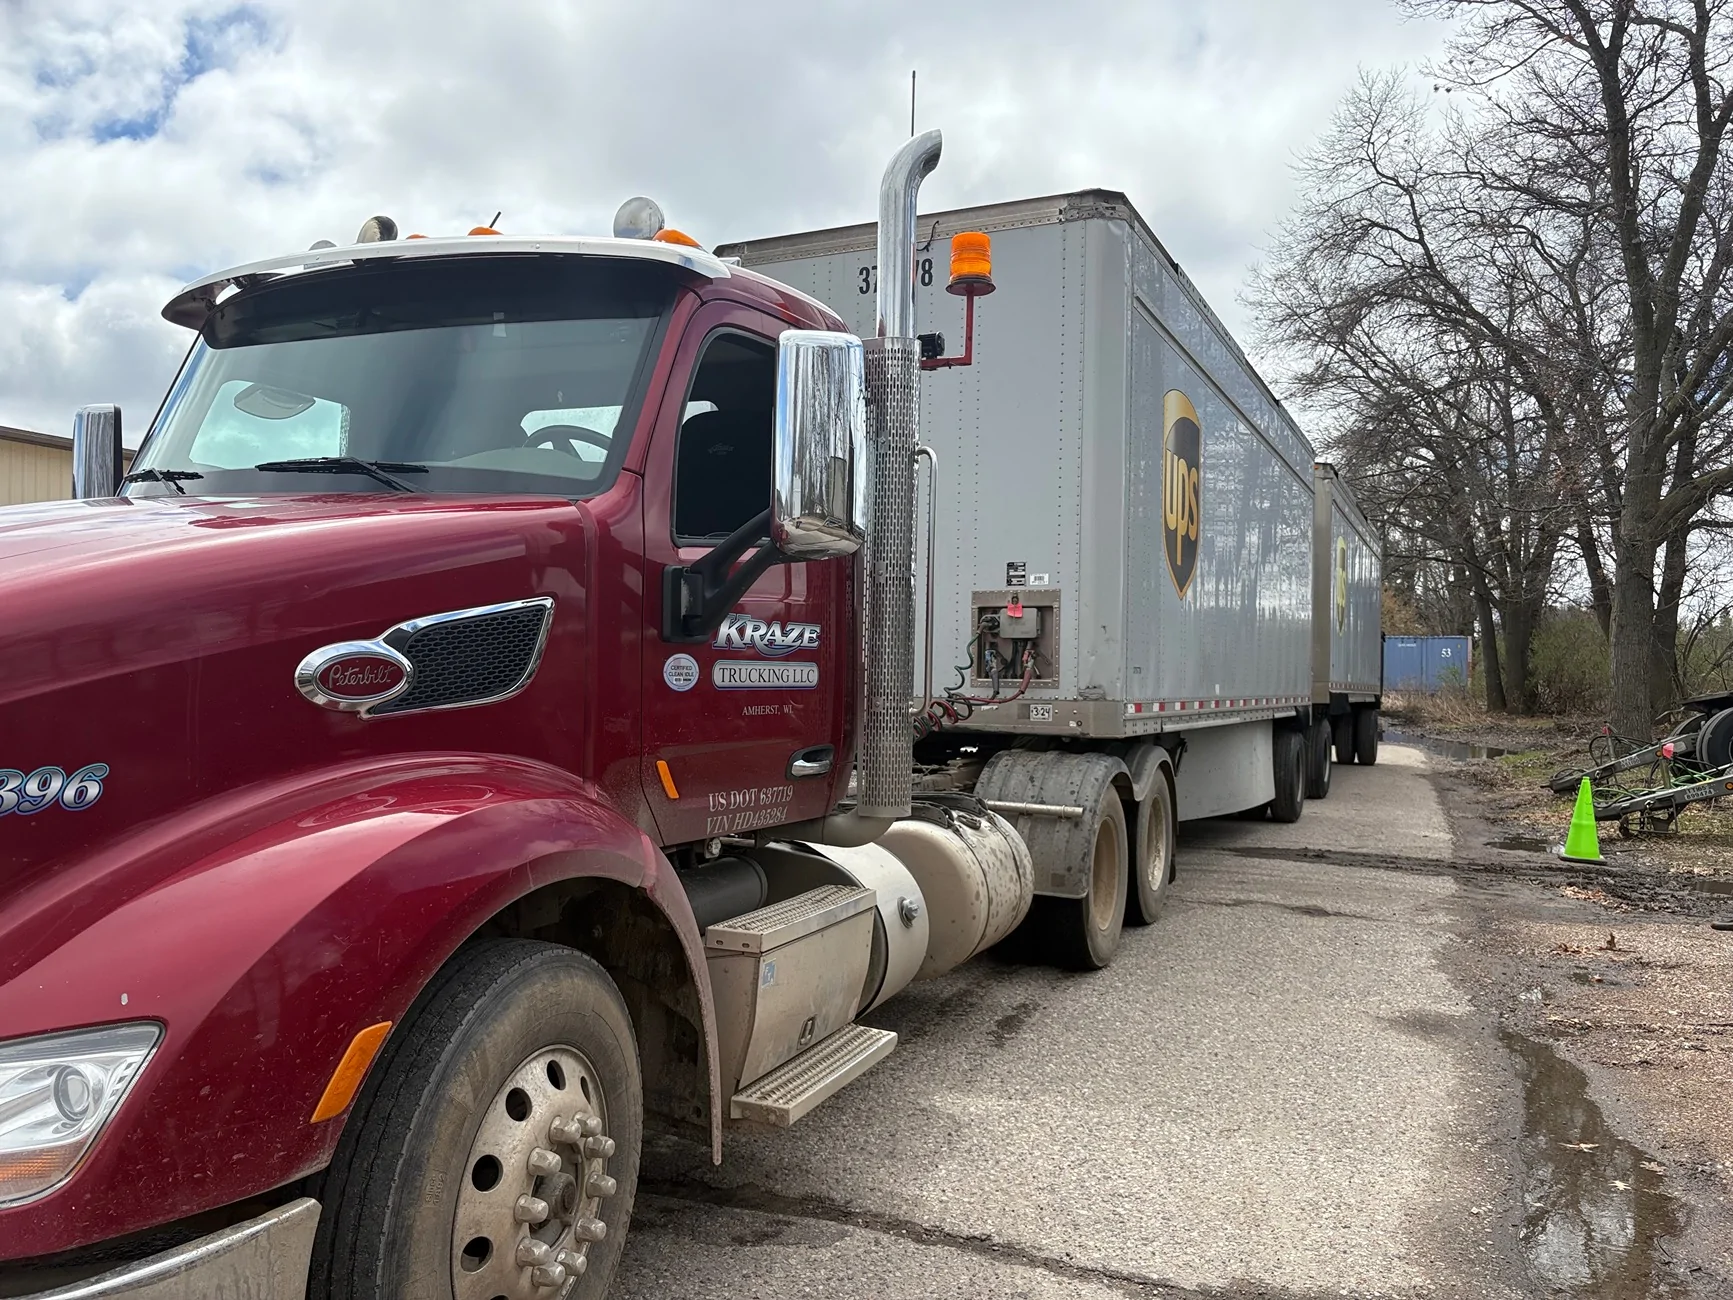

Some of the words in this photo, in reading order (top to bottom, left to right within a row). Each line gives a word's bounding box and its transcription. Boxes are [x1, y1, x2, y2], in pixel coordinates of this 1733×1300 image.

[1165, 448, 1198, 566] ups
[712, 613, 822, 658] KRAZE
[1441, 648, 1451, 658] 53
[329, 664, 398, 689] Peterbilt
[719, 667, 790, 684] TRUCKING
[792, 668, 815, 684] LLC
[742, 704, 781, 716] AMHERST,
[708, 791, 727, 812] US
[729, 788, 758, 810] DOT
[760, 784, 794, 805] 637719
[706, 814, 733, 836] VIN
[732, 806, 788, 831] HD435284
